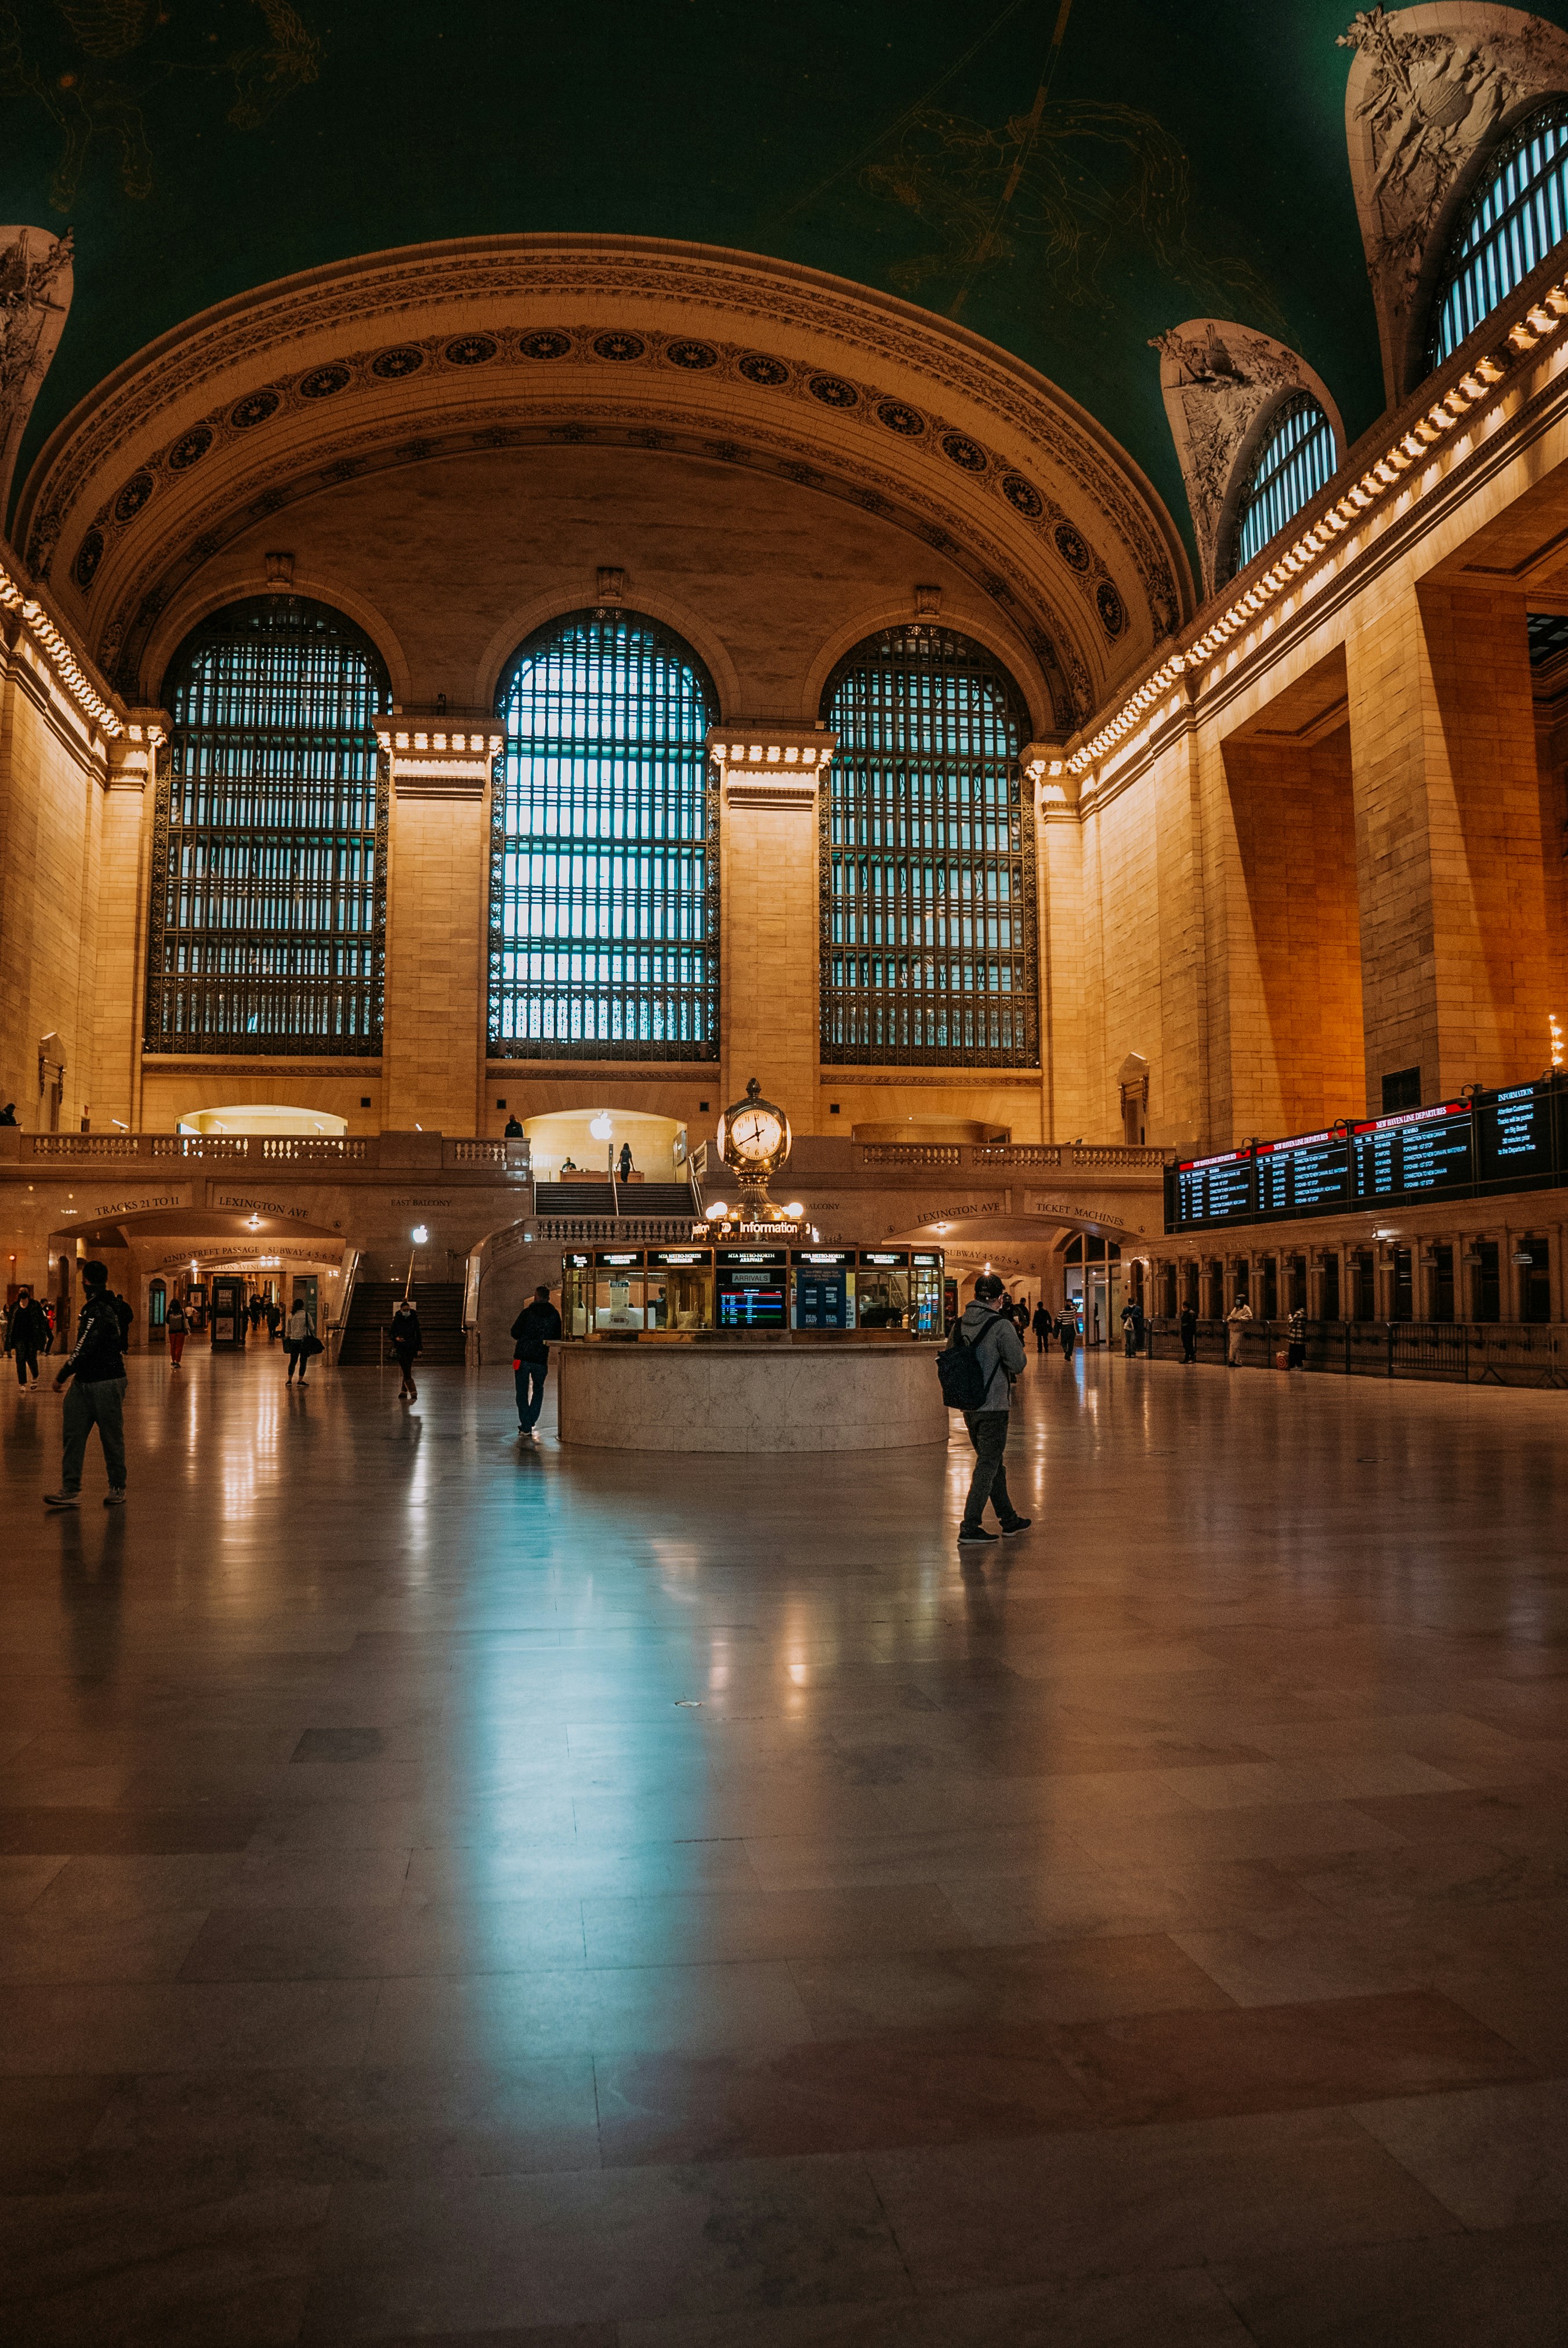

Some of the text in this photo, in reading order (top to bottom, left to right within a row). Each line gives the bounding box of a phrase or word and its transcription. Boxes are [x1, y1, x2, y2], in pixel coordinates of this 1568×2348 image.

[1498, 1088, 1533, 1101] INFORMATION
[1376, 1107, 1447, 1128] NEW HAVEN LINE DEPARTURES
[95, 1196, 179, 1215] TRACKS 21 TO 11
[219, 1197, 309, 1218] LEXINGTON AVE
[918, 1203, 1000, 1223] LEXINGTON AVE
[1036, 1203, 1124, 1226] TICKET MACHINES
[740, 1222, 797, 1233] Information
[163, 1246, 260, 1264] 42ND STREET PASSAGE
[268, 1247, 305, 1257] SUBWAY
[946, 1249, 981, 1258] SUBWAY
